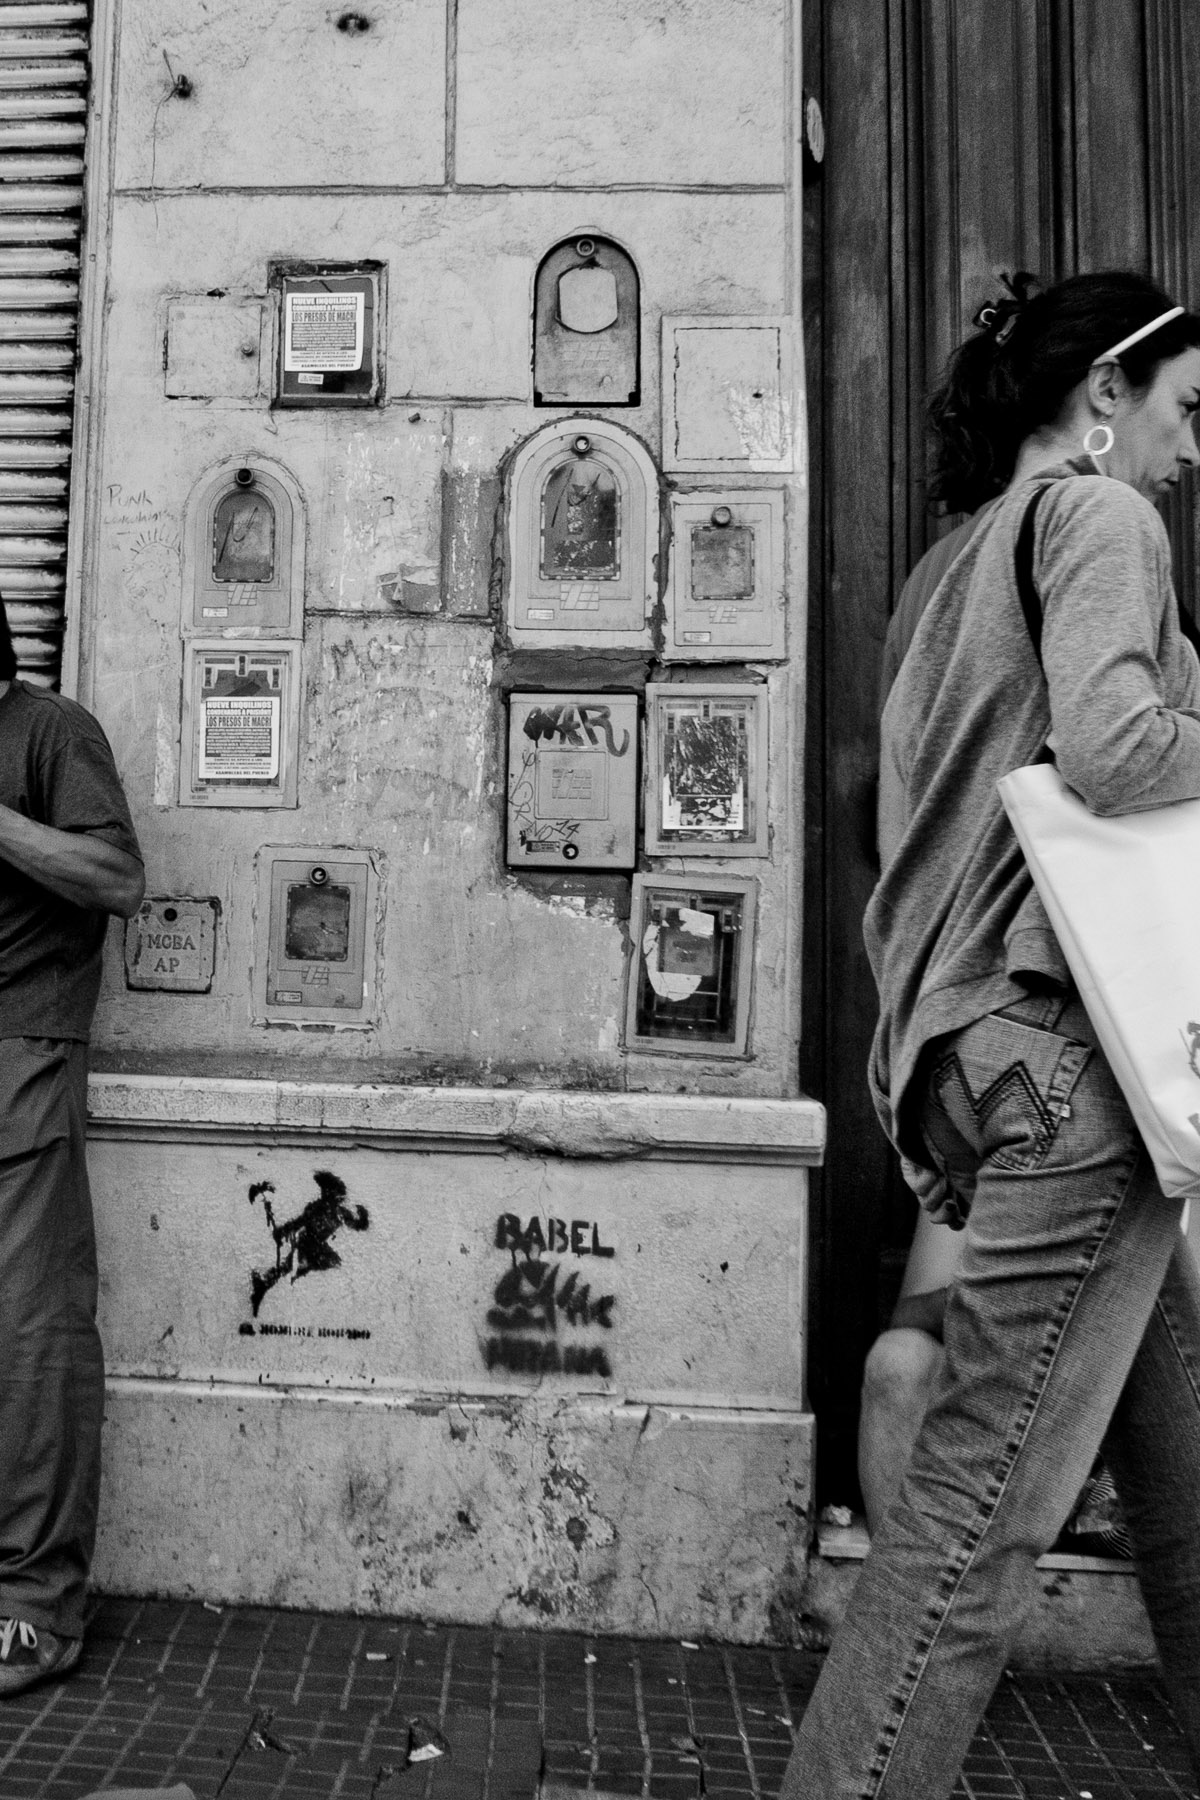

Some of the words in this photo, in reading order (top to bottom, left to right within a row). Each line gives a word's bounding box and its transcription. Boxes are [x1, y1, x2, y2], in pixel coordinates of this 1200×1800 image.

[292, 312, 303, 322] LOS
[304, 312, 327, 322] PRESOS
[328, 311, 336, 321] DE
[336, 311, 356, 321] MACRI
[206, 716, 217, 727] LOS
[218, 716, 242, 727] PRESOS
[242, 716, 251, 727] DE
[251, 716, 272, 727] MACRI
[147, 933, 196, 950] MCBA
[153, 957, 180, 973] AP
[494, 1212, 616, 1258] BABEL
